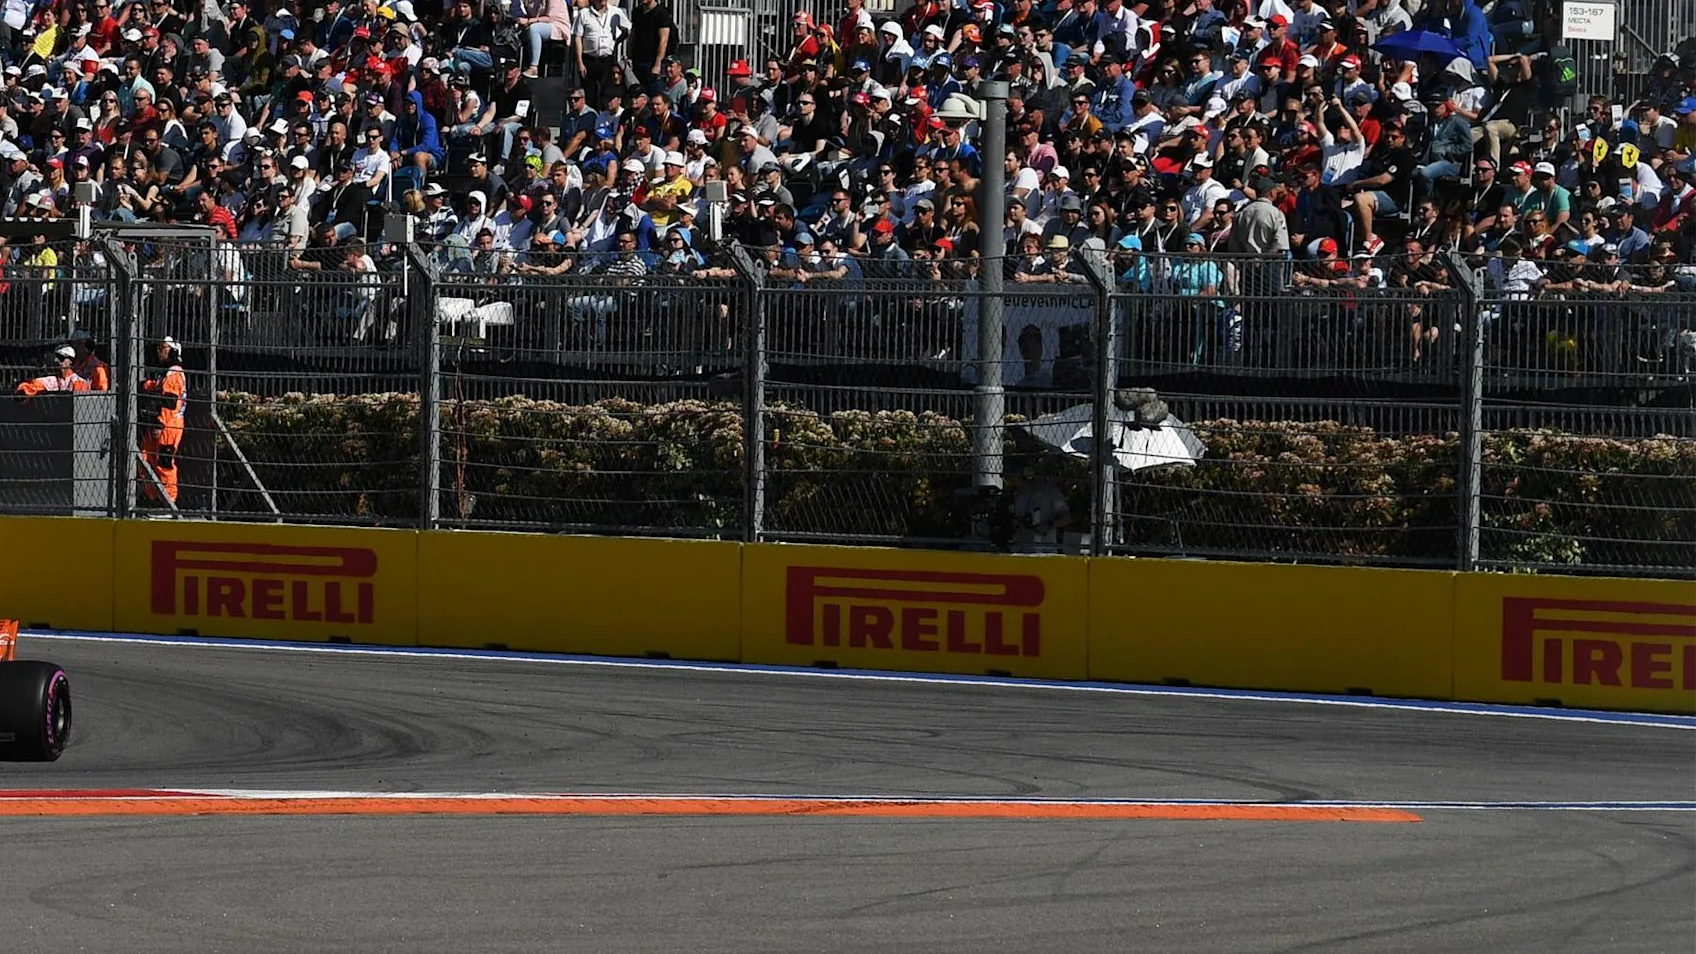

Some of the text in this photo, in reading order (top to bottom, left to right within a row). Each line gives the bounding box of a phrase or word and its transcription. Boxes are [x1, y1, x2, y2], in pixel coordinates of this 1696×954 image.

[1568, 7, 1604, 15] 153-167
[151, 540, 378, 625] PIRELLI
[785, 565, 1045, 658] PIRELLI
